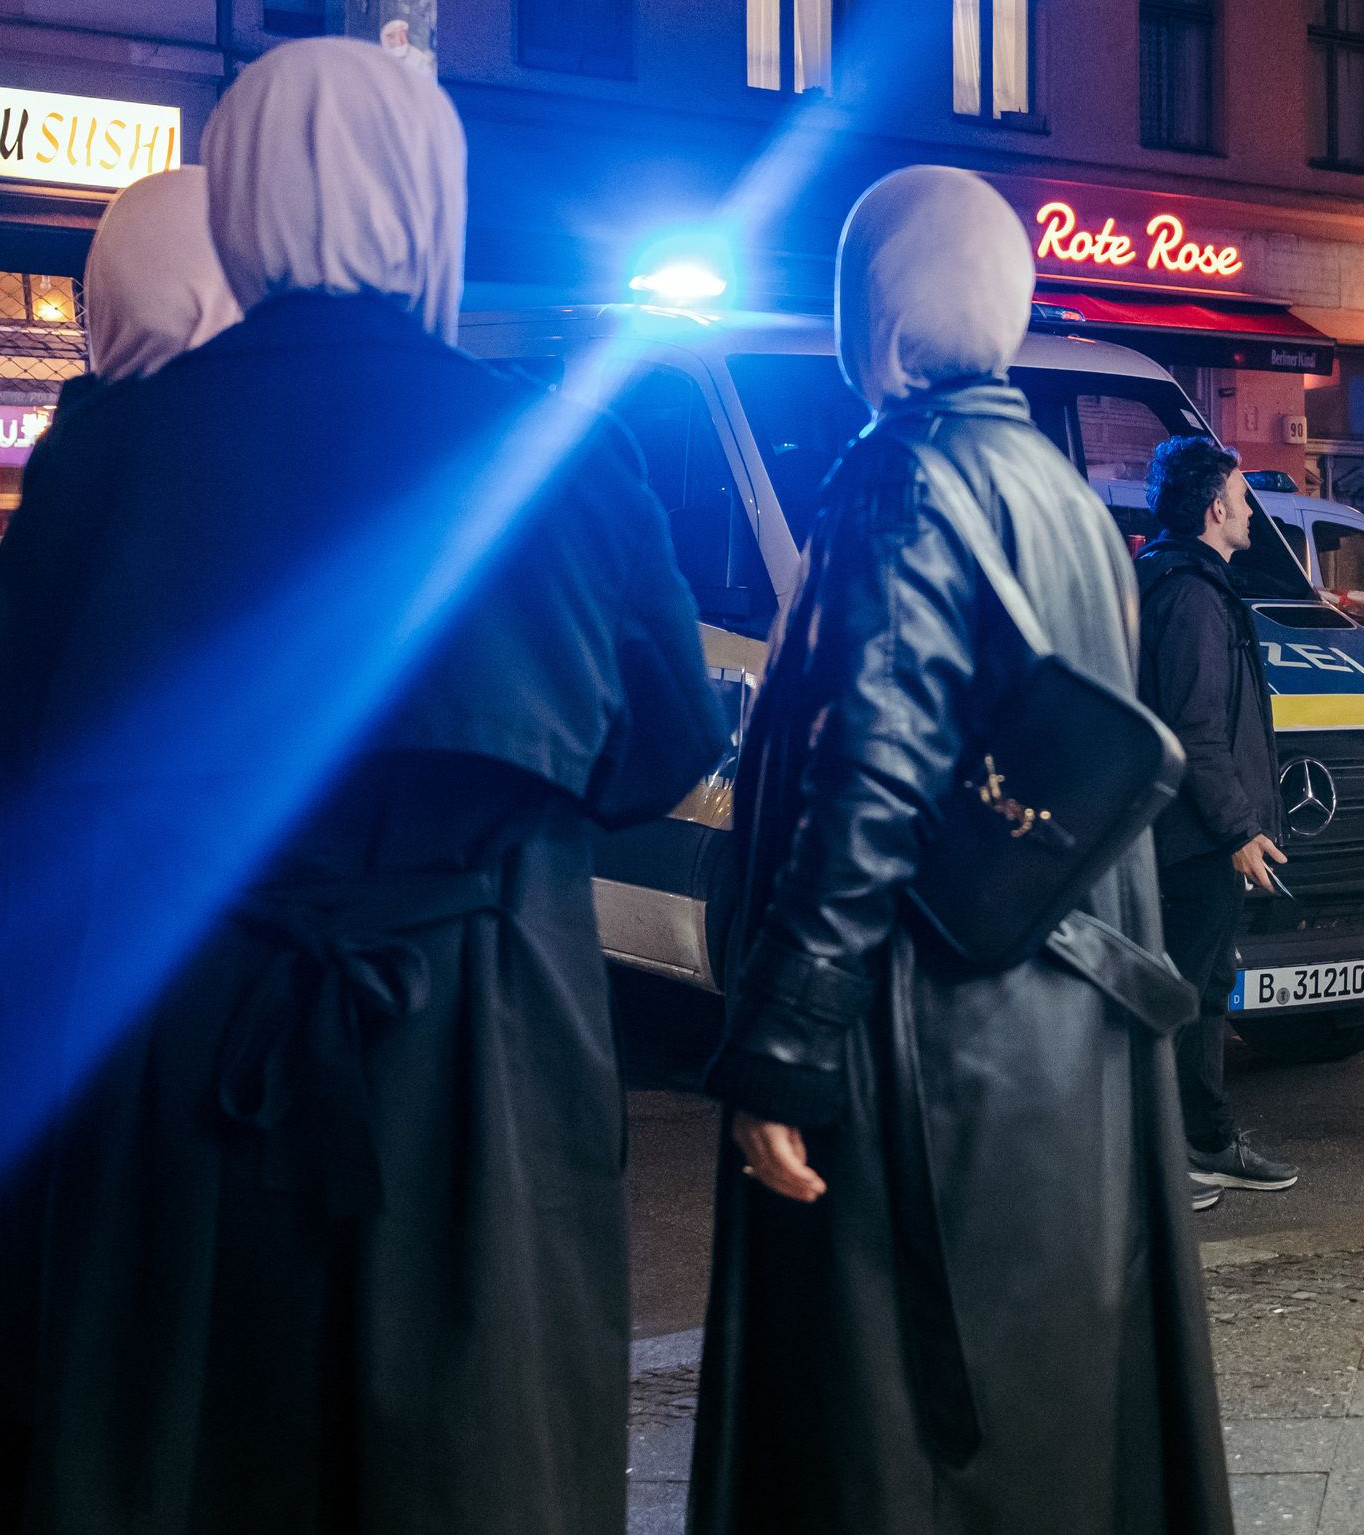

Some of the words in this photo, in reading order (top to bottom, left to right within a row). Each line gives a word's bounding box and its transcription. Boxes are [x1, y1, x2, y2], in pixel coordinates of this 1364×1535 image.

[35, 112, 175, 173] SUSHI
[1036, 202, 1137, 265] Rote
[1146, 214, 1244, 276] Rose
[1290, 422, 1304, 438] 90
[1258, 973, 1275, 1004] B
